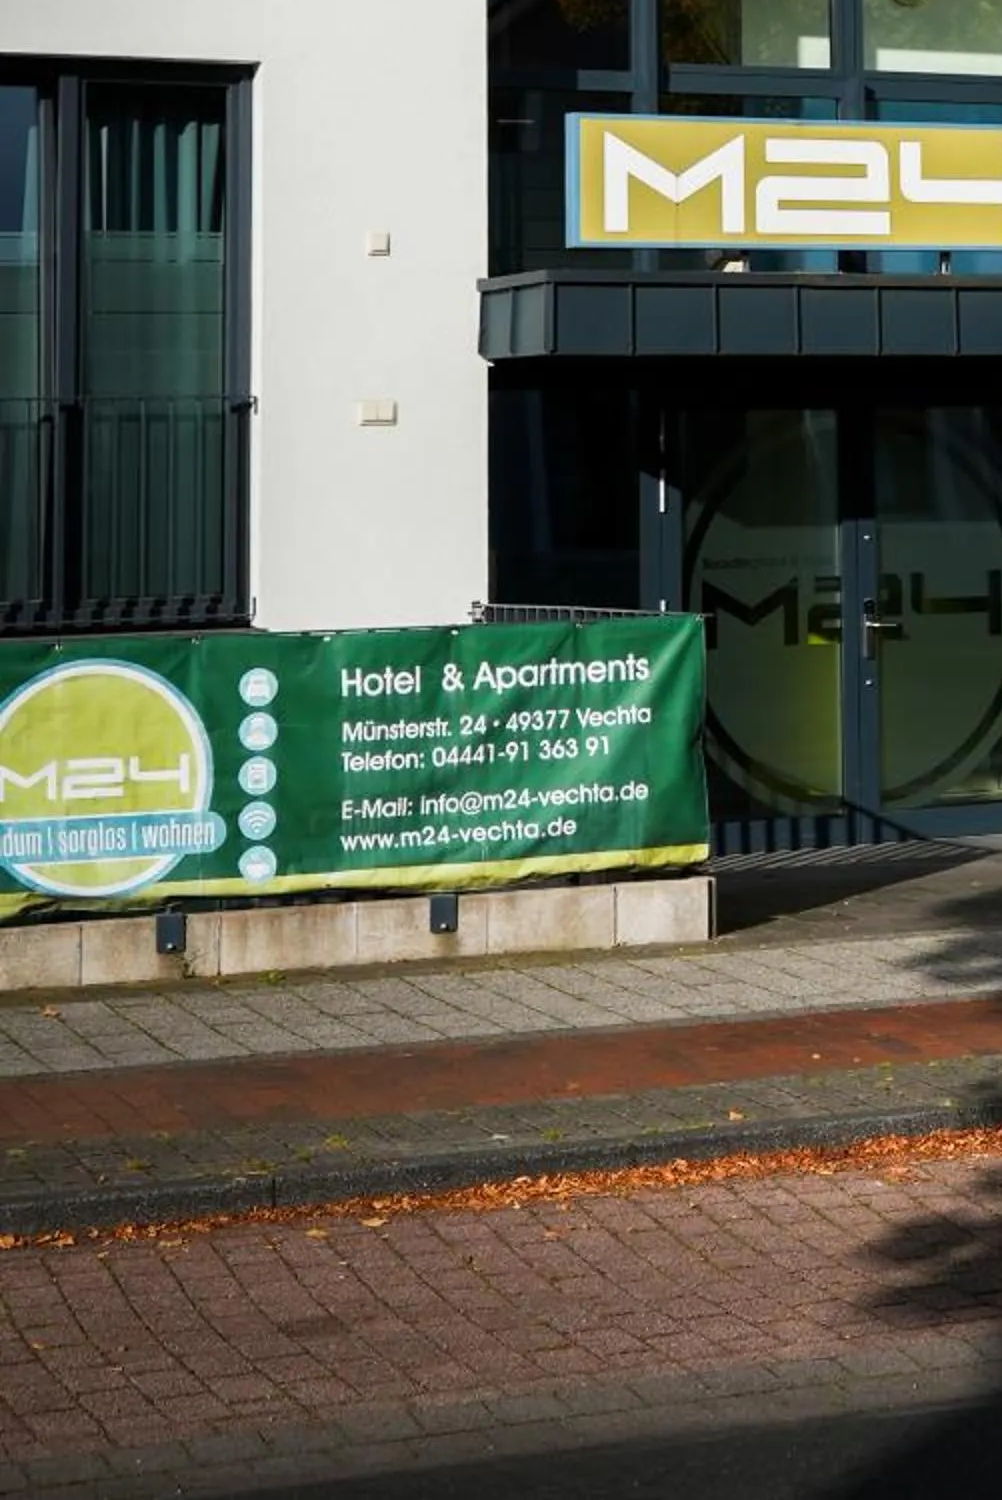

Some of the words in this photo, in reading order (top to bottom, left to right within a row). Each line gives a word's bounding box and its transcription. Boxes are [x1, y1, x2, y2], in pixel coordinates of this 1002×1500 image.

[341, 664, 422, 698] Hotel
[441, 662, 466, 693] &
[473, 653, 651, 695] Apartments
[342, 716, 453, 744] Münsterstr.
[459, 713, 488, 736] 24
[505, 708, 571, 733] 49377
[575, 703, 652, 729] Vechta
[341, 750, 426, 773] Telefon:
[431, 741, 530, 768] 04441-91
[538, 737, 580, 760] 363
[585, 735, 610, 757] 91
[0, 753, 191, 801] M24
[341, 797, 414, 820] E-Mail:
[420, 779, 650, 816] info@m24-vechta.de
[0, 826, 42, 857] dum
[58, 821, 127, 855] sorglos
[142, 819, 215, 848] wohnen
[340, 815, 578, 852] www.m24-vechta.de
